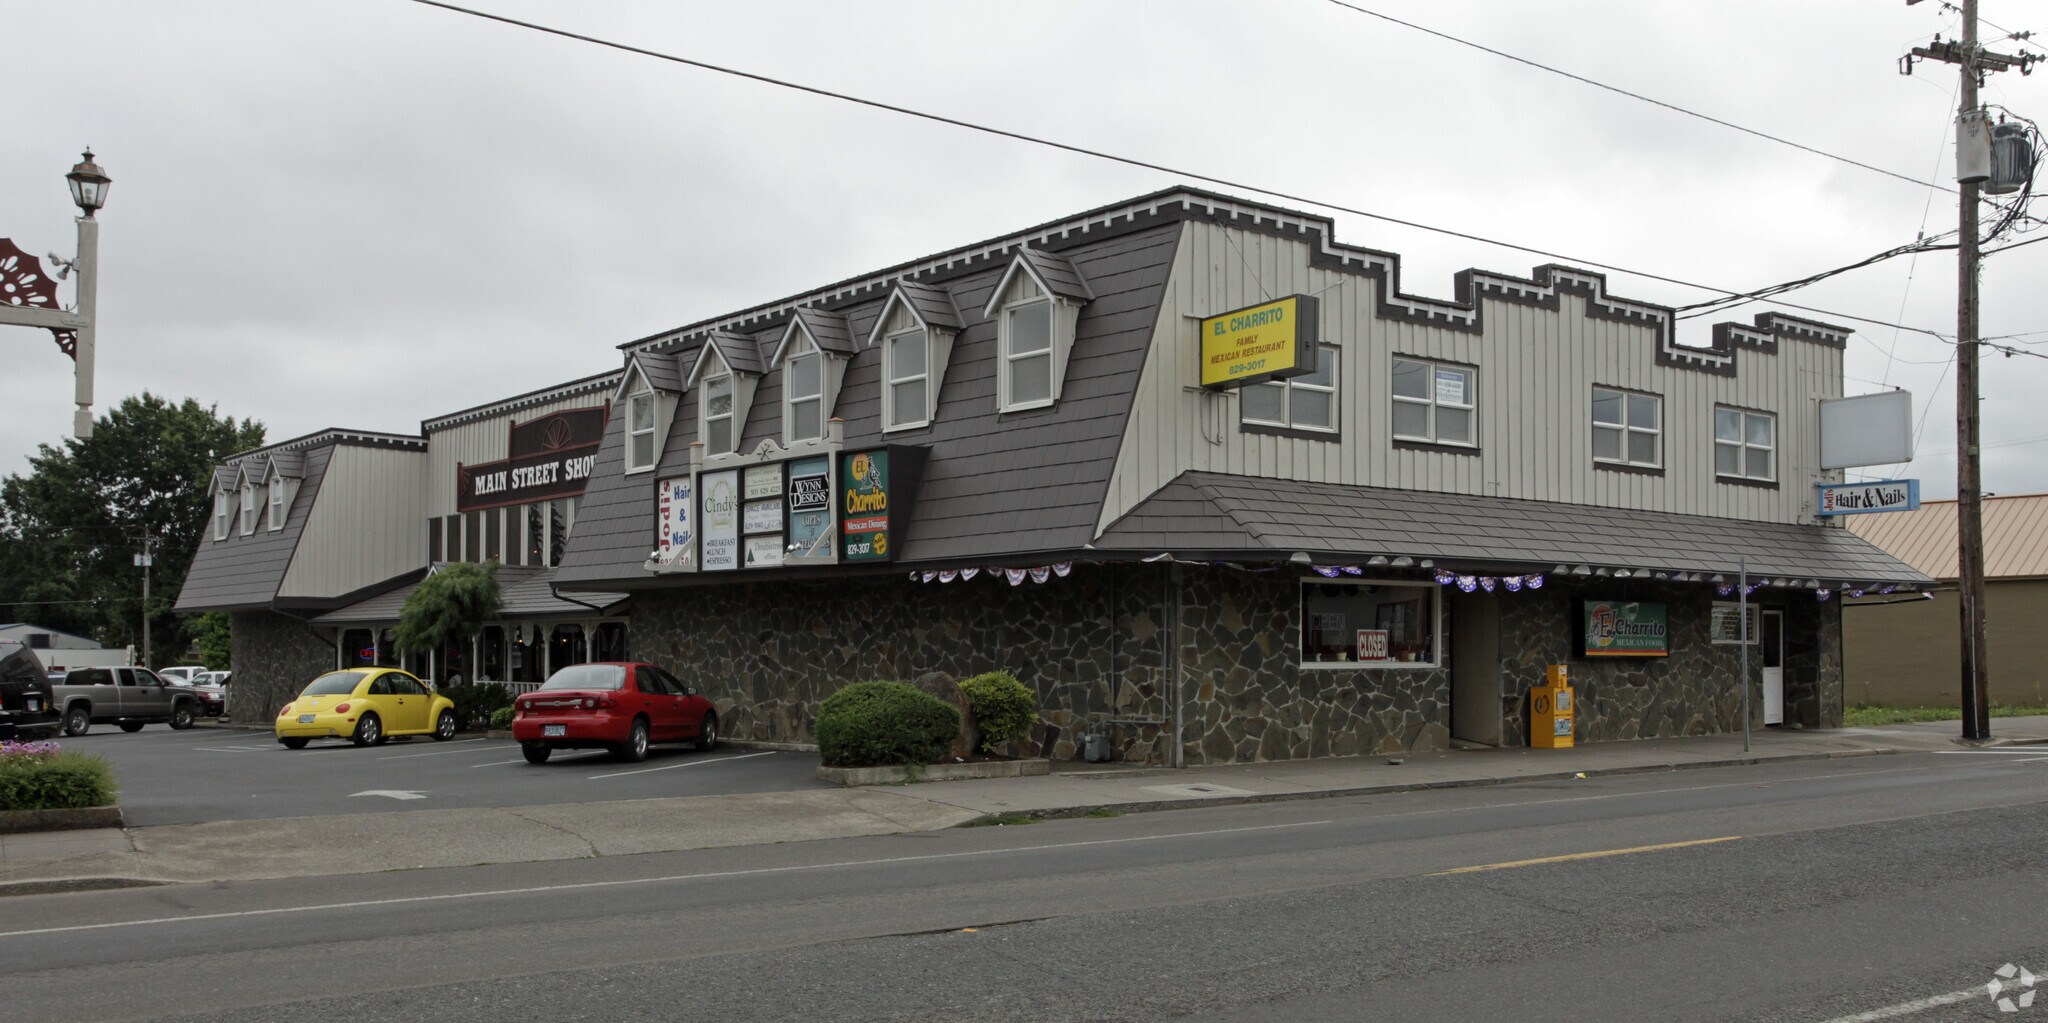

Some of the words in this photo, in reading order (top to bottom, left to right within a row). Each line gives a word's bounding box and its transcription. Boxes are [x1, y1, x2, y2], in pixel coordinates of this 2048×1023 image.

[1214, 320, 1227, 336] EL
[1230, 307, 1283, 332] CHARRITO
[1236, 334, 1259, 347] FAMILY
[1210, 350, 1240, 365] MEXICAN
[1241, 340, 1286, 358] RESTAURANT
[1229, 358, 1266, 375] 829-3017
[855, 460, 865, 474] EL
[475, 471, 508, 495] MAIN
[511, 461, 559, 489] STREET
[674, 486, 691, 501] Hair
[795, 480, 822, 494] WYNN
[794, 491, 827, 507] DESIGNS
[846, 486, 886, 514] Charrito
[1835, 491, 1861, 509] Hair
[1862, 487, 1874, 509] &
[1875, 487, 1906, 508] Nails
[705, 496, 739, 517] Cindy's
[745, 504, 760, 513] SPACE
[660, 480, 671, 553] Jodi's
[679, 508, 686, 522] &
[801, 514, 821, 526] GIFTS
[847, 520, 868, 531] Mexican
[868, 518, 887, 530] Dining
[709, 538, 736, 548] BREAKFAST
[709, 548, 726, 556] LUNCH
[709, 556, 731, 565] ESPRESSO
[1313, 614, 1345, 629] OPEN
[1599, 608, 1617, 638] El
[1614, 616, 1664, 636] Charrito
[1359, 634, 1387, 657] CLOSED
[1616, 638, 1644, 647] MEXICAN
